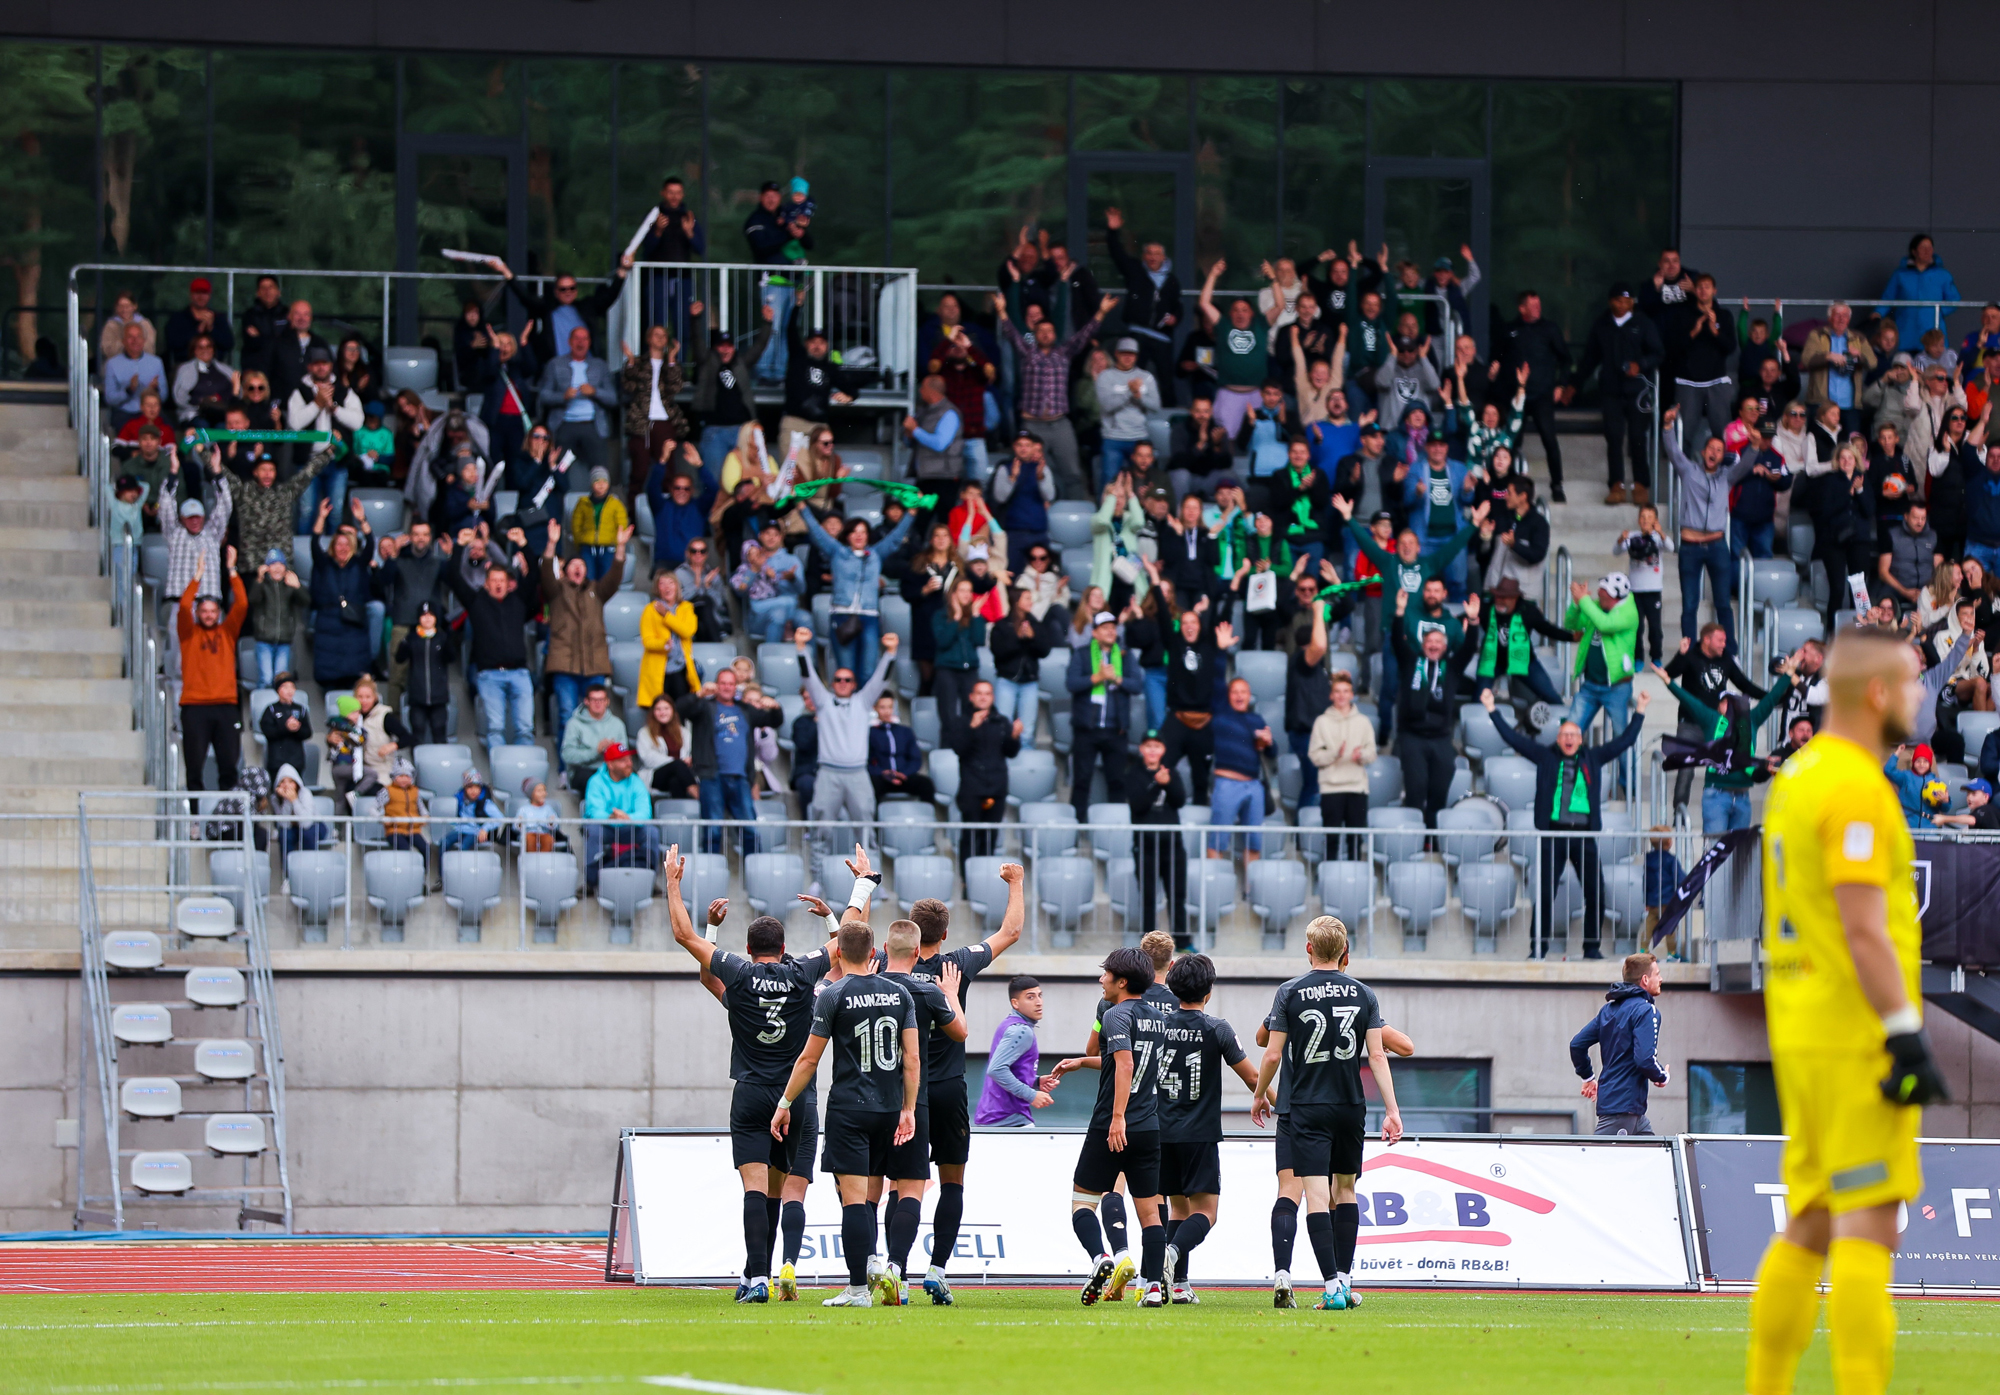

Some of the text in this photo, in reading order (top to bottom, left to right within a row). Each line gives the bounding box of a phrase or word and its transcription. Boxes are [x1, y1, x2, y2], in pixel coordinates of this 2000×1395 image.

[845, 992, 901, 1010] JAUNZEMS
[1297, 981, 1358, 1002] TOŅIŠEVS
[756, 996, 788, 1044] 3
[854, 1015, 899, 1073] 10
[1298, 1005, 1361, 1064] 23
[1159, 1048, 1203, 1101] 41
[1951, 1188, 2000, 1237] F
[1360, 1258, 1403, 1270] būvēt
[1417, 1257, 1456, 1270] domā
[1461, 1259, 1510, 1272] RB&B!
[1906, 1252, 1921, 1260] UN
[1974, 1253, 2000, 1261] VEIK
